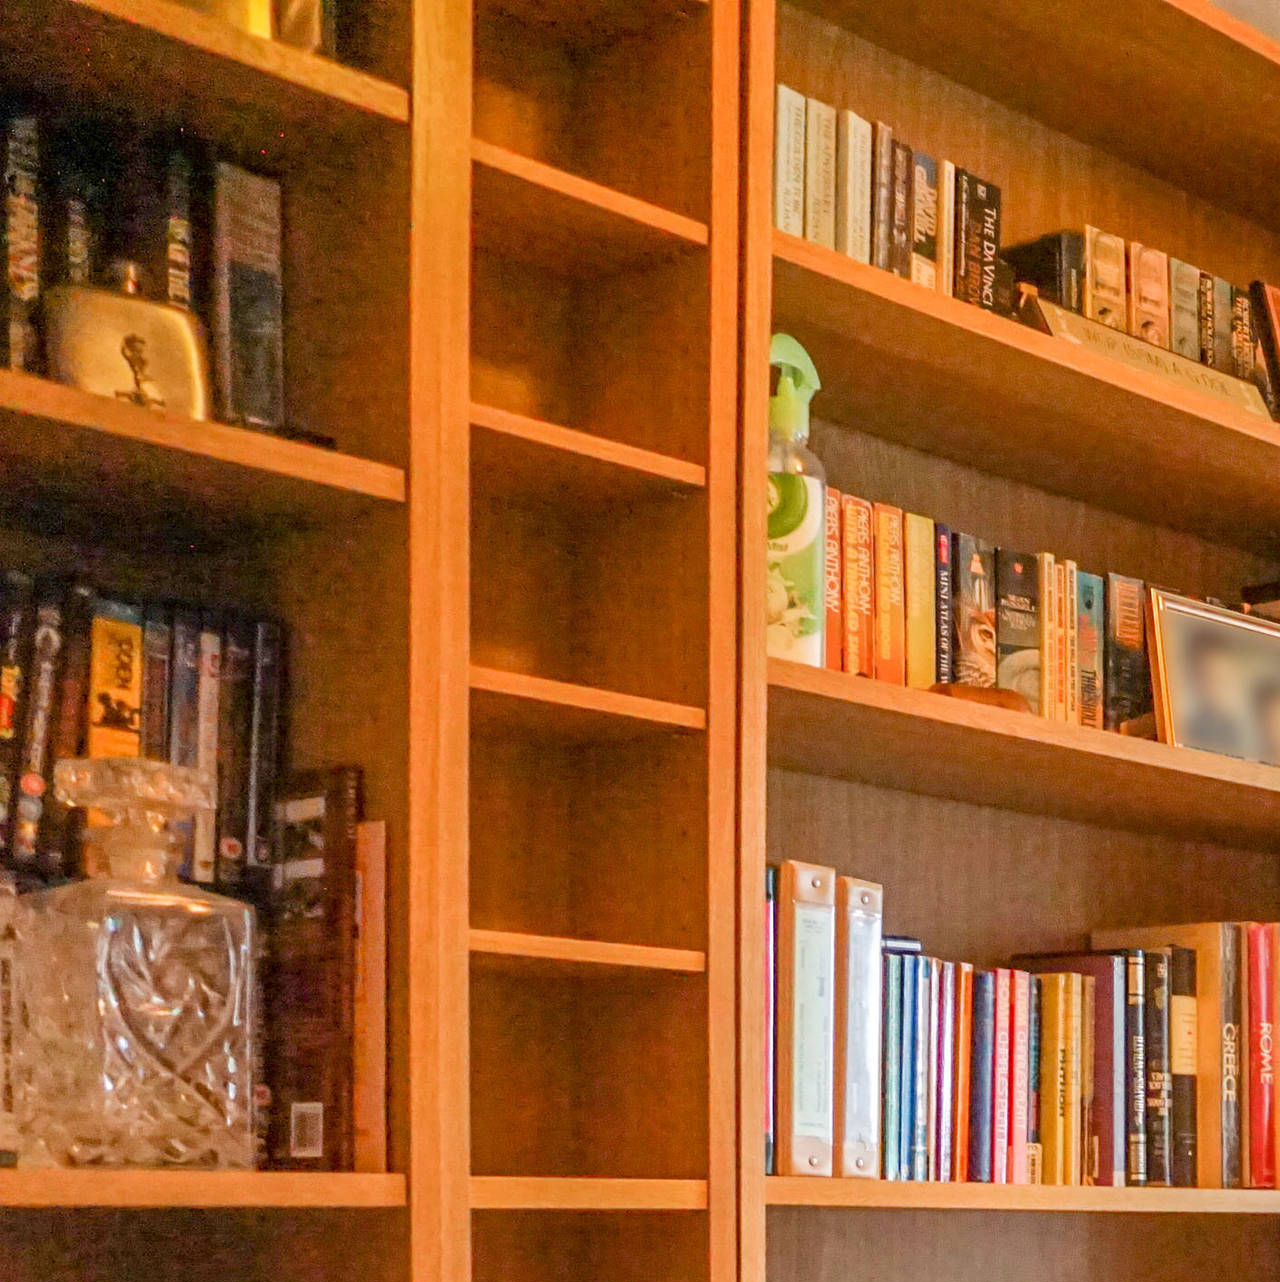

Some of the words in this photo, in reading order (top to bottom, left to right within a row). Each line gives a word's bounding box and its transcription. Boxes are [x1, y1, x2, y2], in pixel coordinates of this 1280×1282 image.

[925, 188, 938, 237] DAVID
[983, 208, 997, 239] THE
[983, 241, 996, 263] DA
[982, 265, 995, 307] VINCI
[826, 497, 839, 538] PIERS
[857, 507, 870, 545] PIERS
[888, 514, 900, 546] PIERS
[825, 539, 841, 613] ANTHONY
[857, 546, 872, 616] ANTHONY
[887, 547, 902, 607] ANTHONY
[939, 570, 949, 599] MINI
[939, 602, 950, 637] ATLAS
[940, 637, 950, 651] OF
[1080, 670, 1097, 728] THRESHOL
[998, 1030, 1009, 1095] CHARLES
[1016, 1030, 1026, 1087] CHARLES
[1222, 1022, 1237, 1101] GREECE
[1259, 1022, 1274, 1084] ROME
[1015, 1090, 1026, 1130] PLATT
